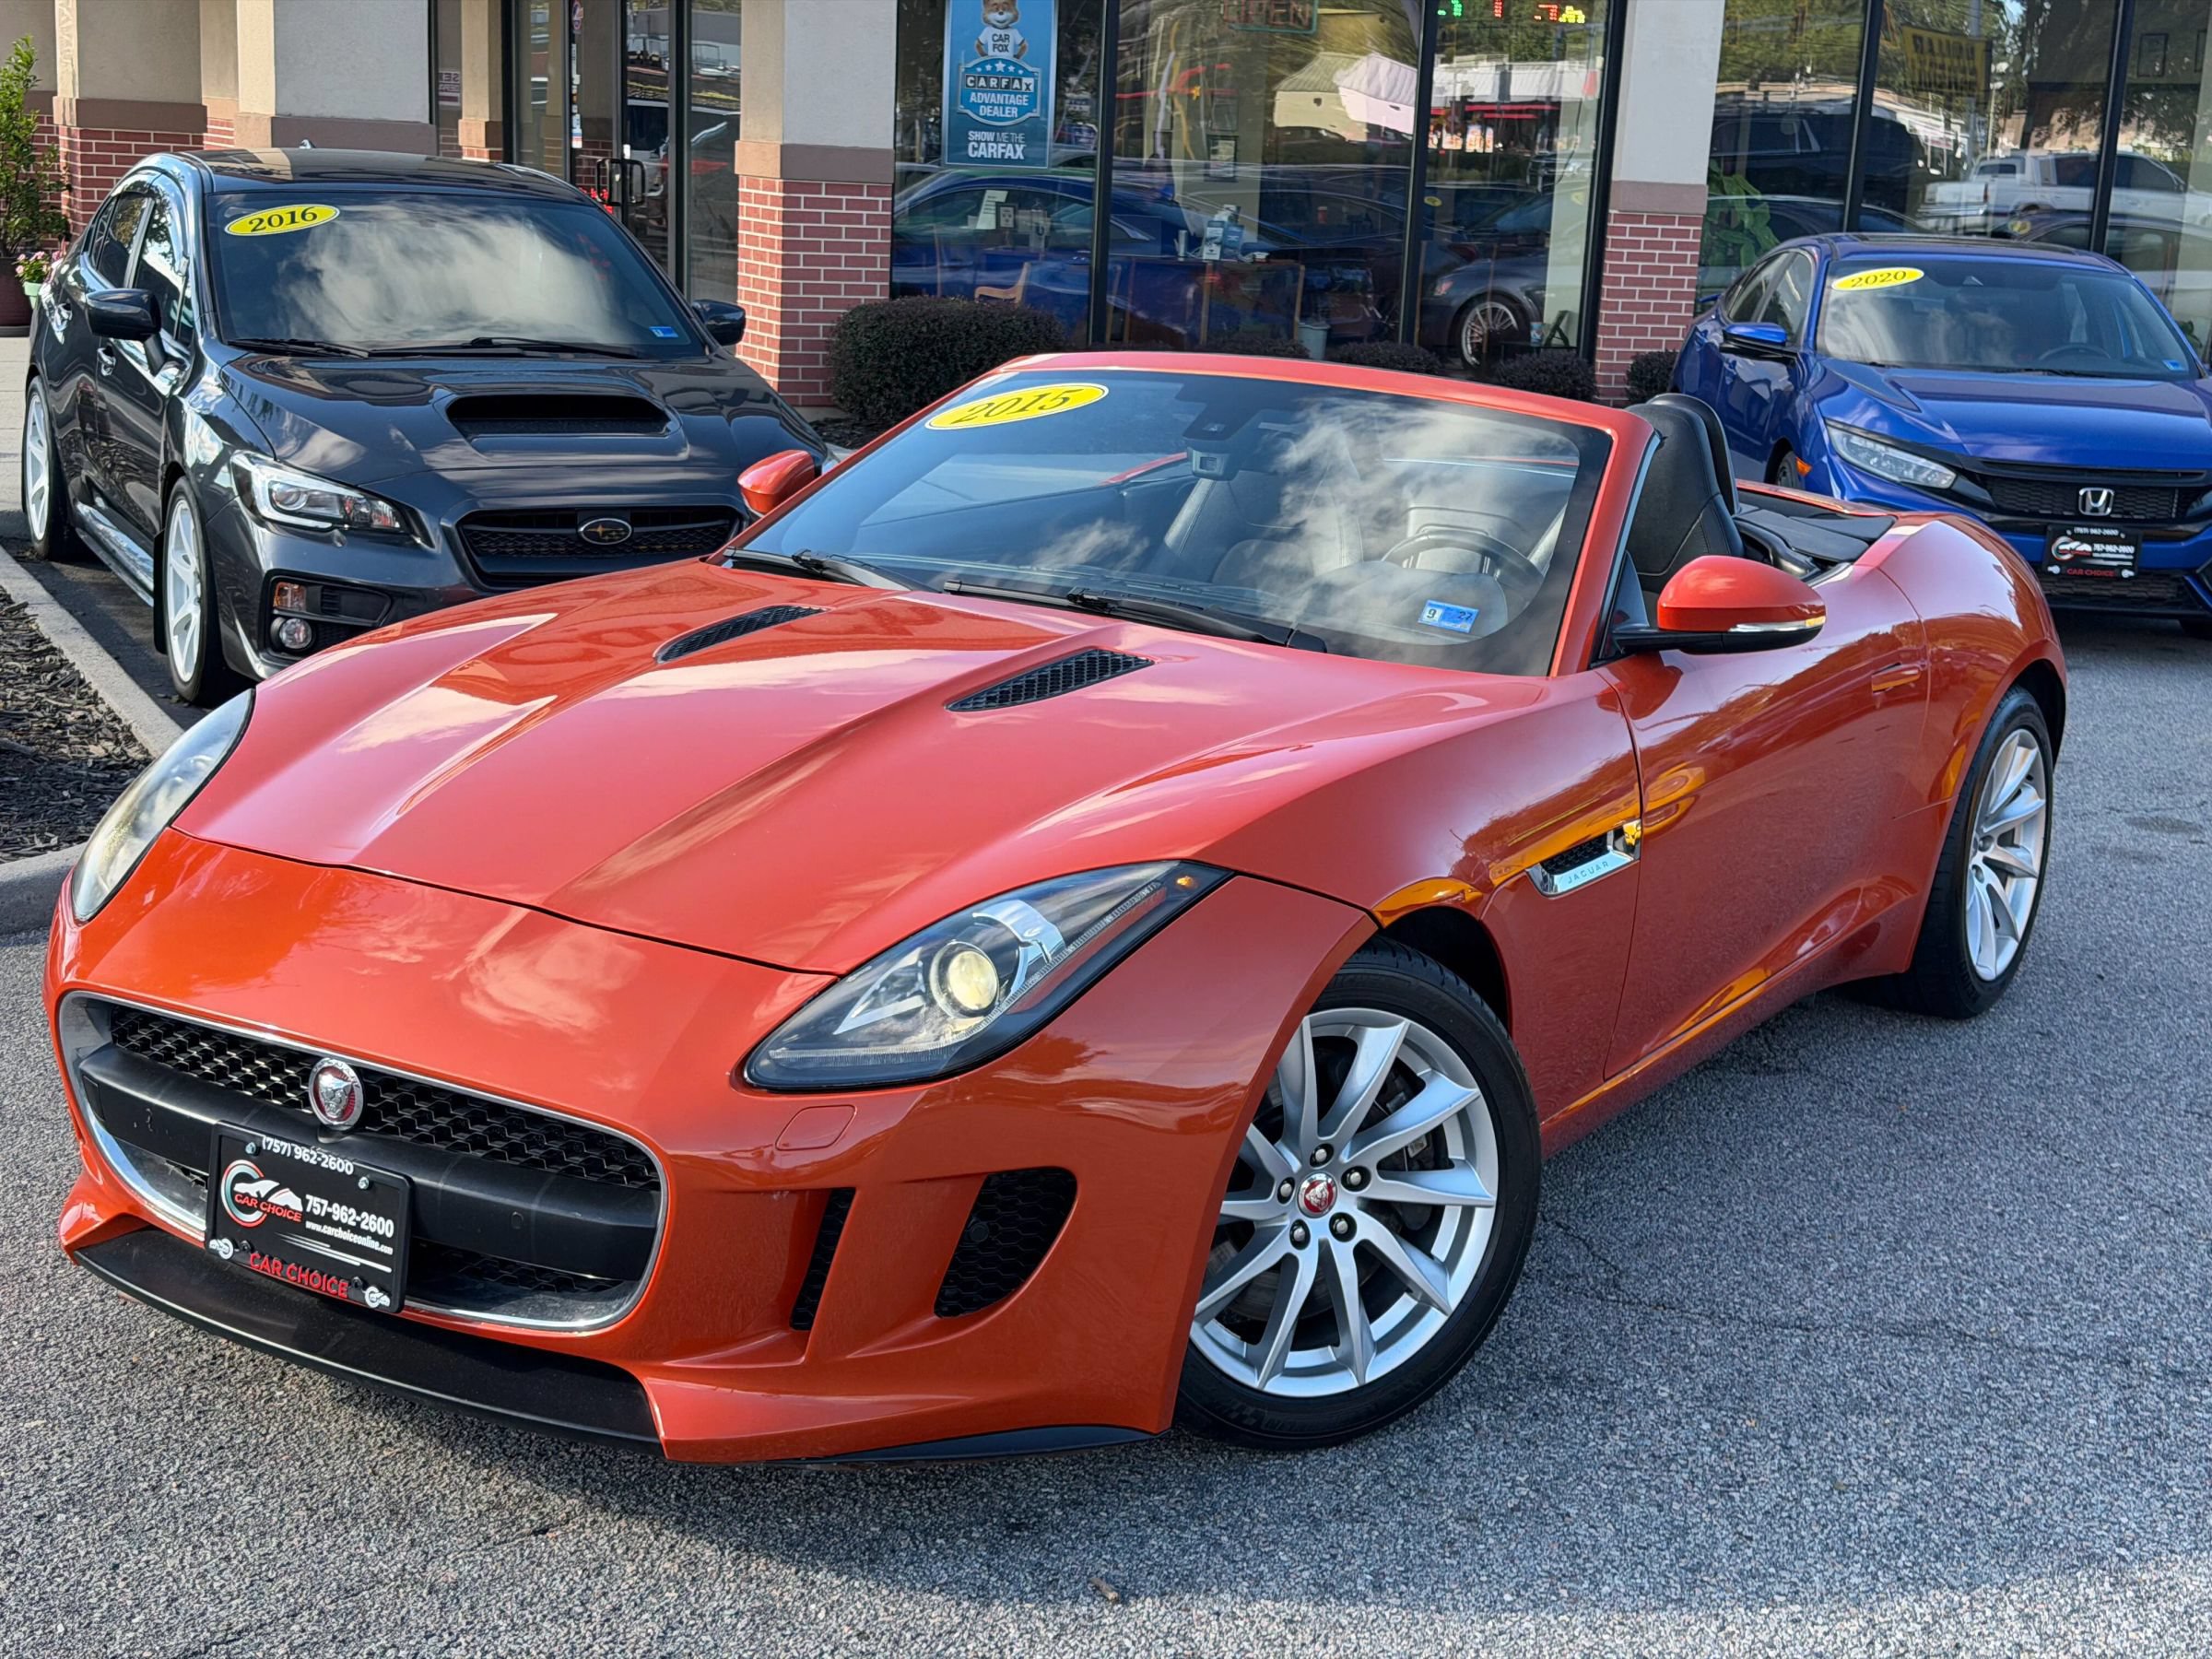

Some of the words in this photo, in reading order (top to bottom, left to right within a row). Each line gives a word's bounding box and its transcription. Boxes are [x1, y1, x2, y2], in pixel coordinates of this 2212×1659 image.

[992, 33, 1011, 43] CAR
[992, 43, 1010, 53] FOX
[965, 75, 1034, 92] CARFAX
[970, 92, 1030, 106] ADVANTAGE
[979, 106, 1018, 118] DEALER
[968, 130, 995, 142] SHOW
[968, 142, 1026, 160] CARFAX
[248, 207, 318, 233] 2016
[1851, 271, 1907, 288] 2020
[950, 388, 1085, 425] 2015
[1426, 608, 1437, 618] 9
[1568, 861, 1609, 884] JAGUAR
[262, 1136, 292, 1157] (757)
[294, 1147, 354, 1175] 962-2600
[234, 1194, 258, 1208] CAR
[259, 1200, 302, 1222] CHOICE
[305, 1194, 394, 1238] 757-962-2600
[305, 1220, 394, 1255] www.carchoiceonline.com
[250, 1253, 282, 1276] CAR
[286, 1265, 348, 1299] CHOICE
